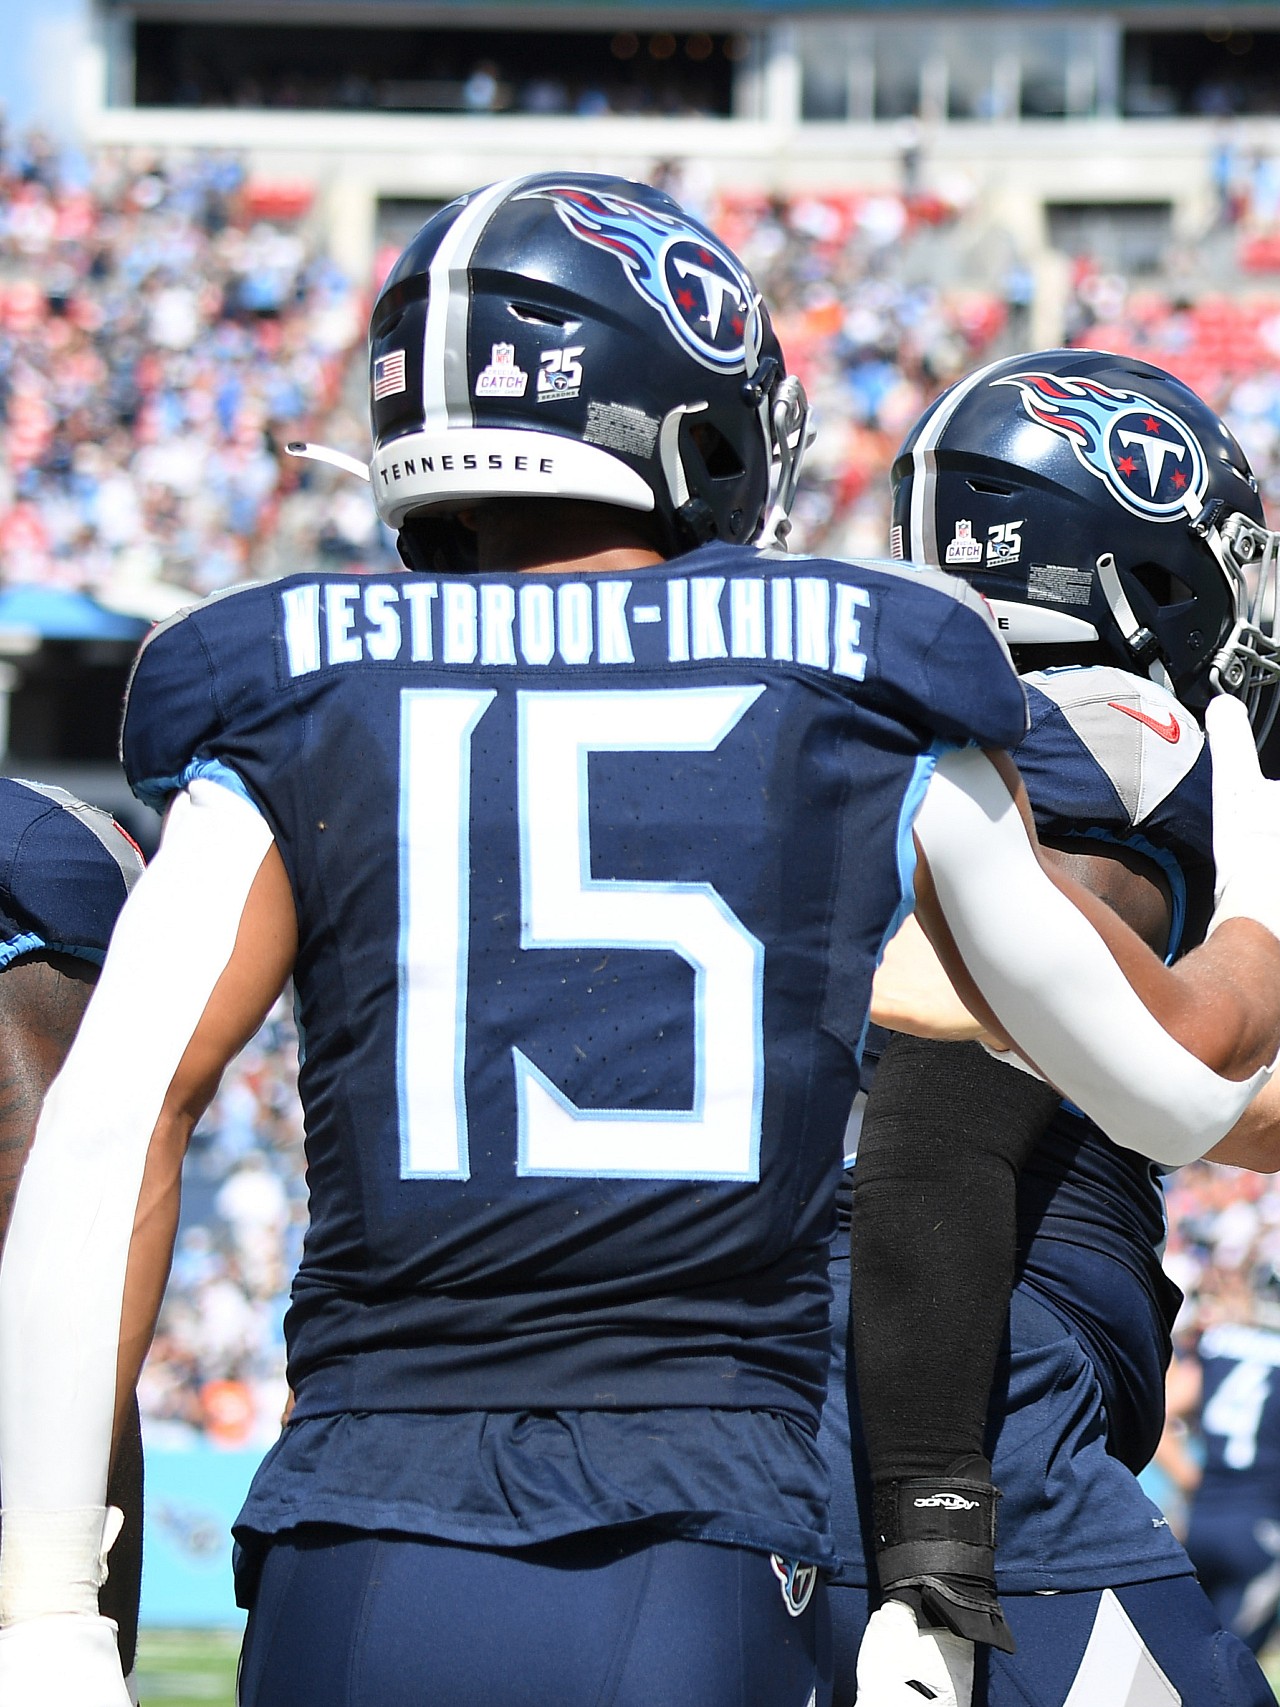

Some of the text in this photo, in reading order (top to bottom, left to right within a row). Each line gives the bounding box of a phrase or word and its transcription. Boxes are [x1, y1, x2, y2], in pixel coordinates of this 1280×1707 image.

[481, 376, 524, 388] CATCH
[537, 346, 585, 395] 25
[380, 454, 555, 486] TENNESSEE
[949, 545, 980, 557] CATCH
[986, 520, 1024, 559] 25
[282, 576, 871, 682] WESTBROOK-IKHINE
[397, 684, 768, 1182] 15
